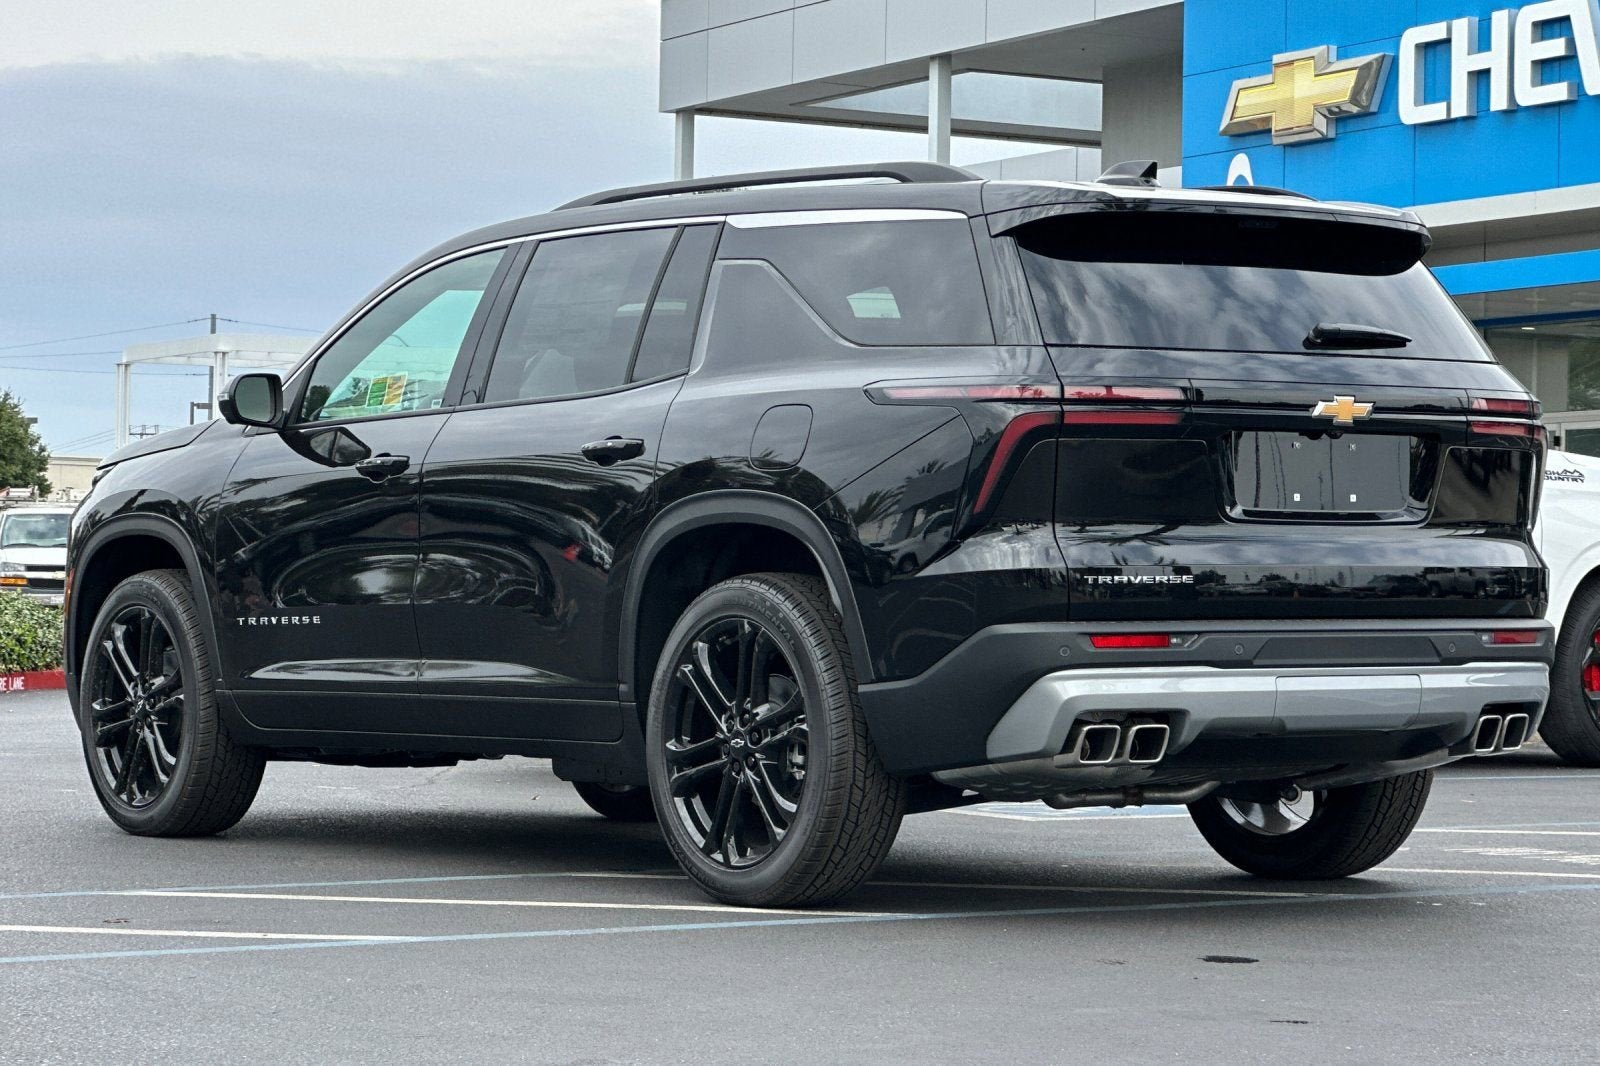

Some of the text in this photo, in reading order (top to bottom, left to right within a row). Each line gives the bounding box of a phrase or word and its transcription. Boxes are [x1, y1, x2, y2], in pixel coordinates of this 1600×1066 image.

[1083, 575, 1194, 584] TRAVERSE
[236, 615, 321, 625] TRAVERSE
[9, 676, 24, 690] LANE
